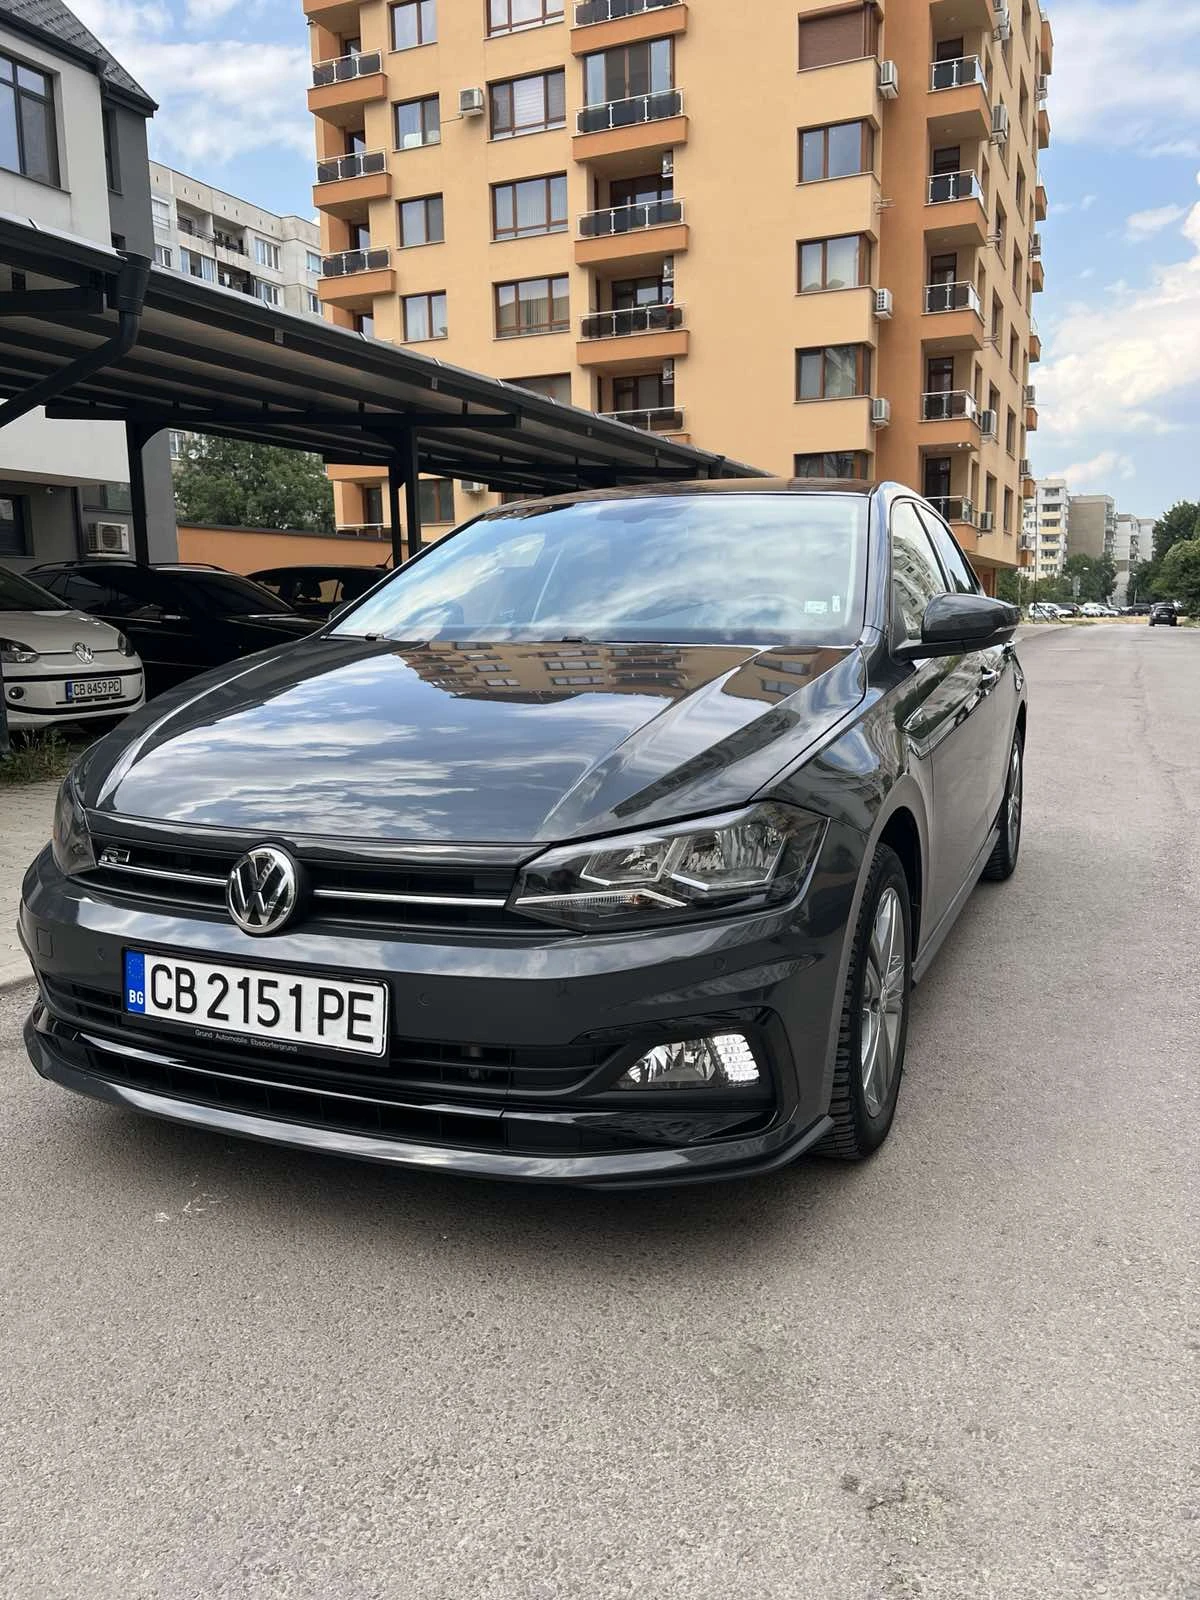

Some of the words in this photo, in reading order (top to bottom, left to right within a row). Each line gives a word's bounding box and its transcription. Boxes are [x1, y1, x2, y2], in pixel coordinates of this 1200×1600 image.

[74, 684, 85, 695] CB
[87, 682, 107, 694] 8459
[108, 681, 119, 692] PC
[129, 989, 143, 1004] BG
[150, 964, 198, 1014] CB
[207, 972, 301, 1033] 2151
[317, 986, 374, 1044] PE
[195, 1029, 213, 1038] Grund
[215, 1033, 247, 1044] Automobile
[250, 1038, 298, 1053] Ebsdorfergrund
